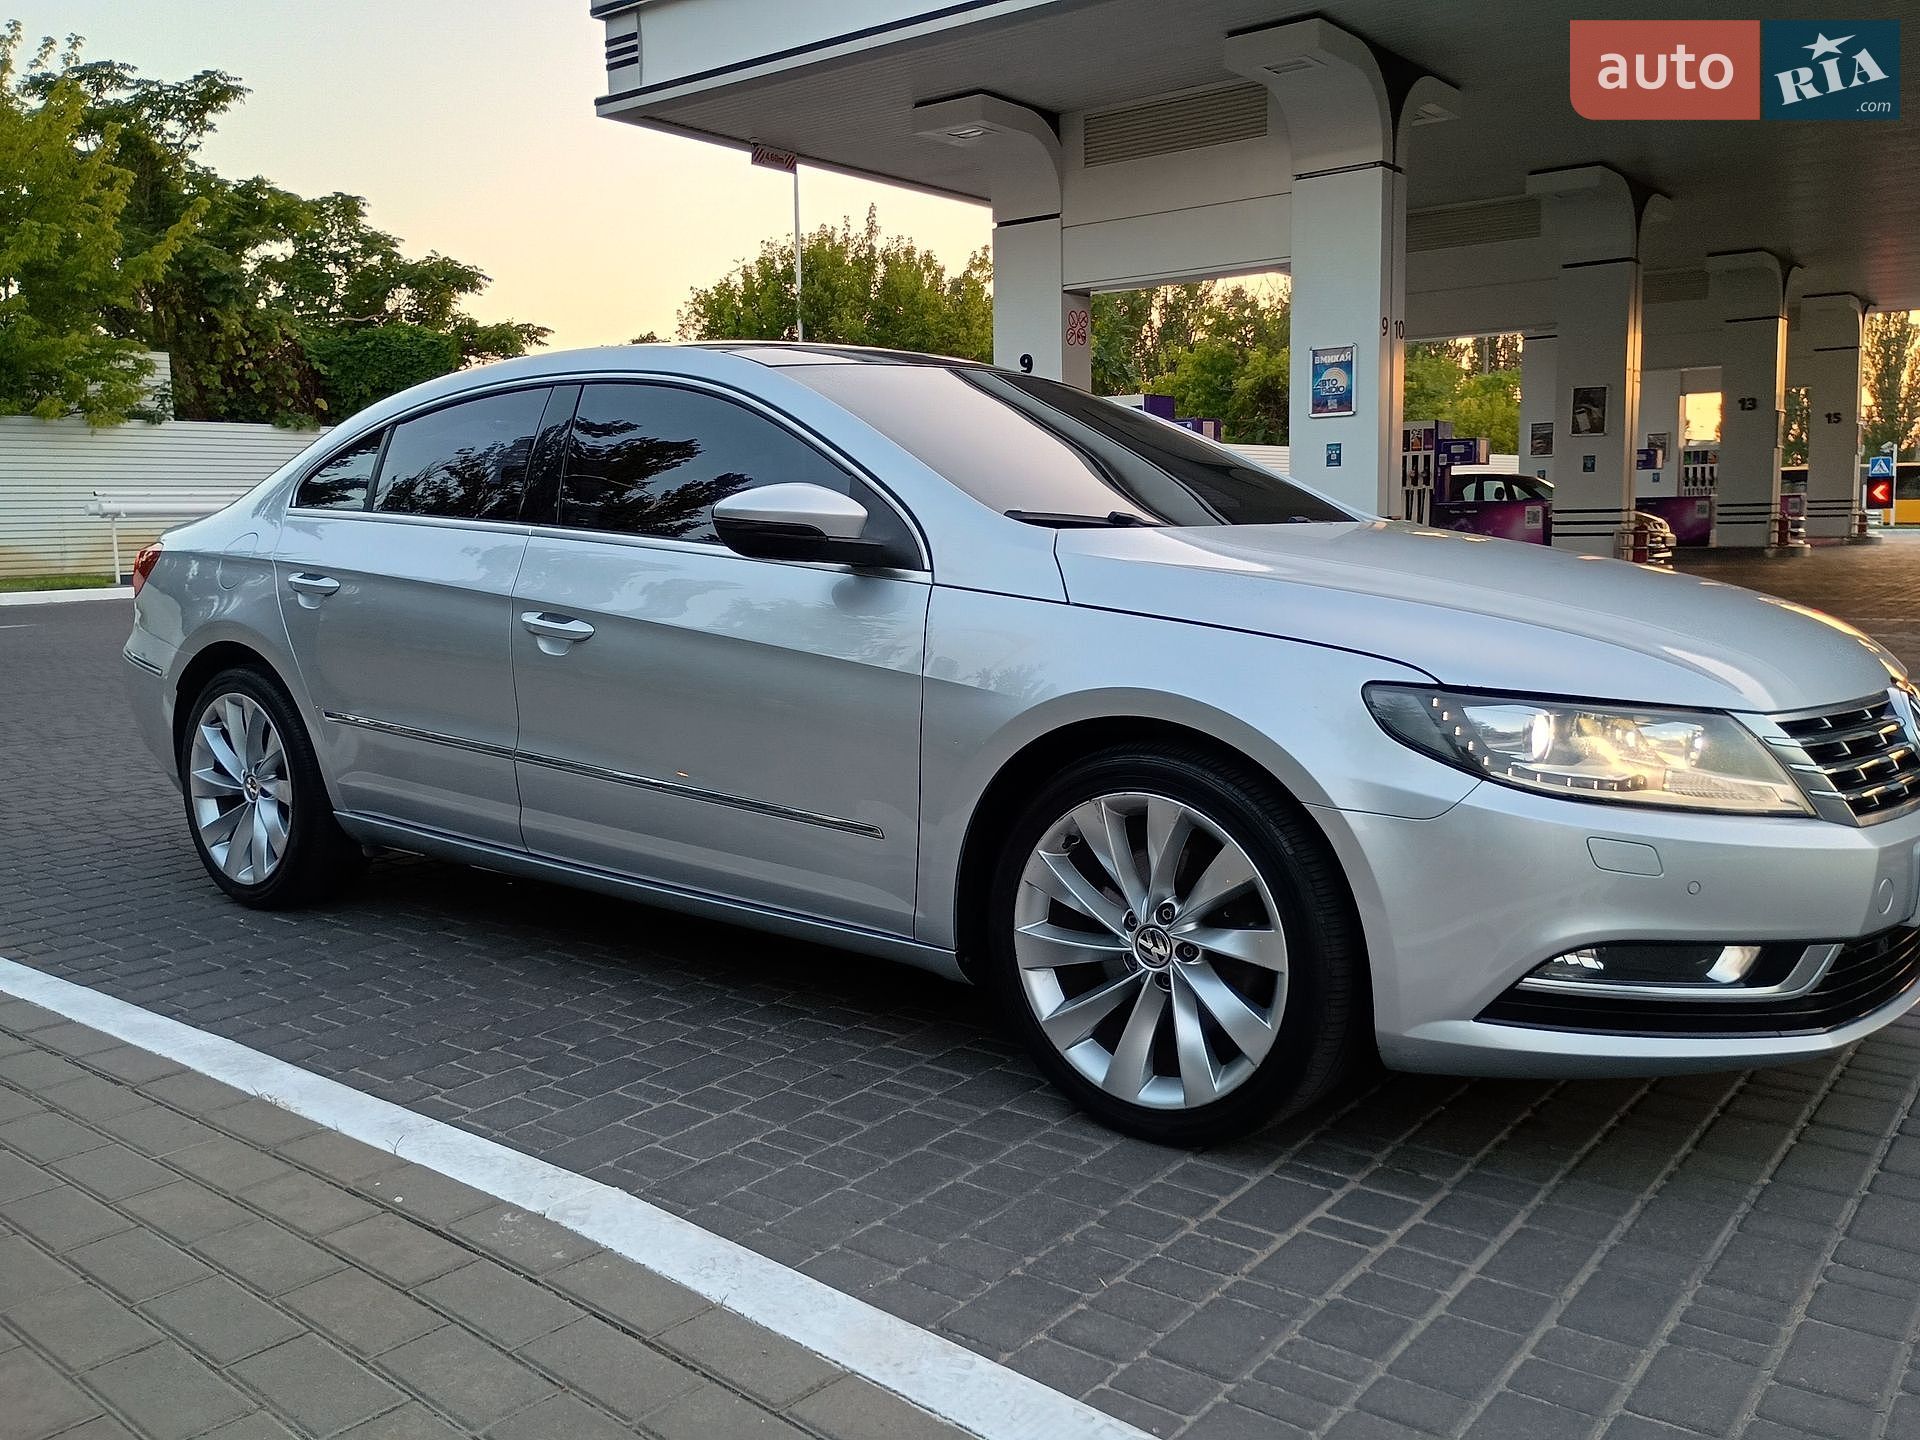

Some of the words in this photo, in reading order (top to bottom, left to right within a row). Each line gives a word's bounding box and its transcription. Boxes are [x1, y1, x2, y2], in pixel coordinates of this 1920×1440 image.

[1382, 317, 1389, 337] 9
[1394, 320, 1405, 340] 10
[1020, 353, 1034, 374] 9
[1738, 397, 1757, 411] 13
[1825, 412, 1842, 424] 15
